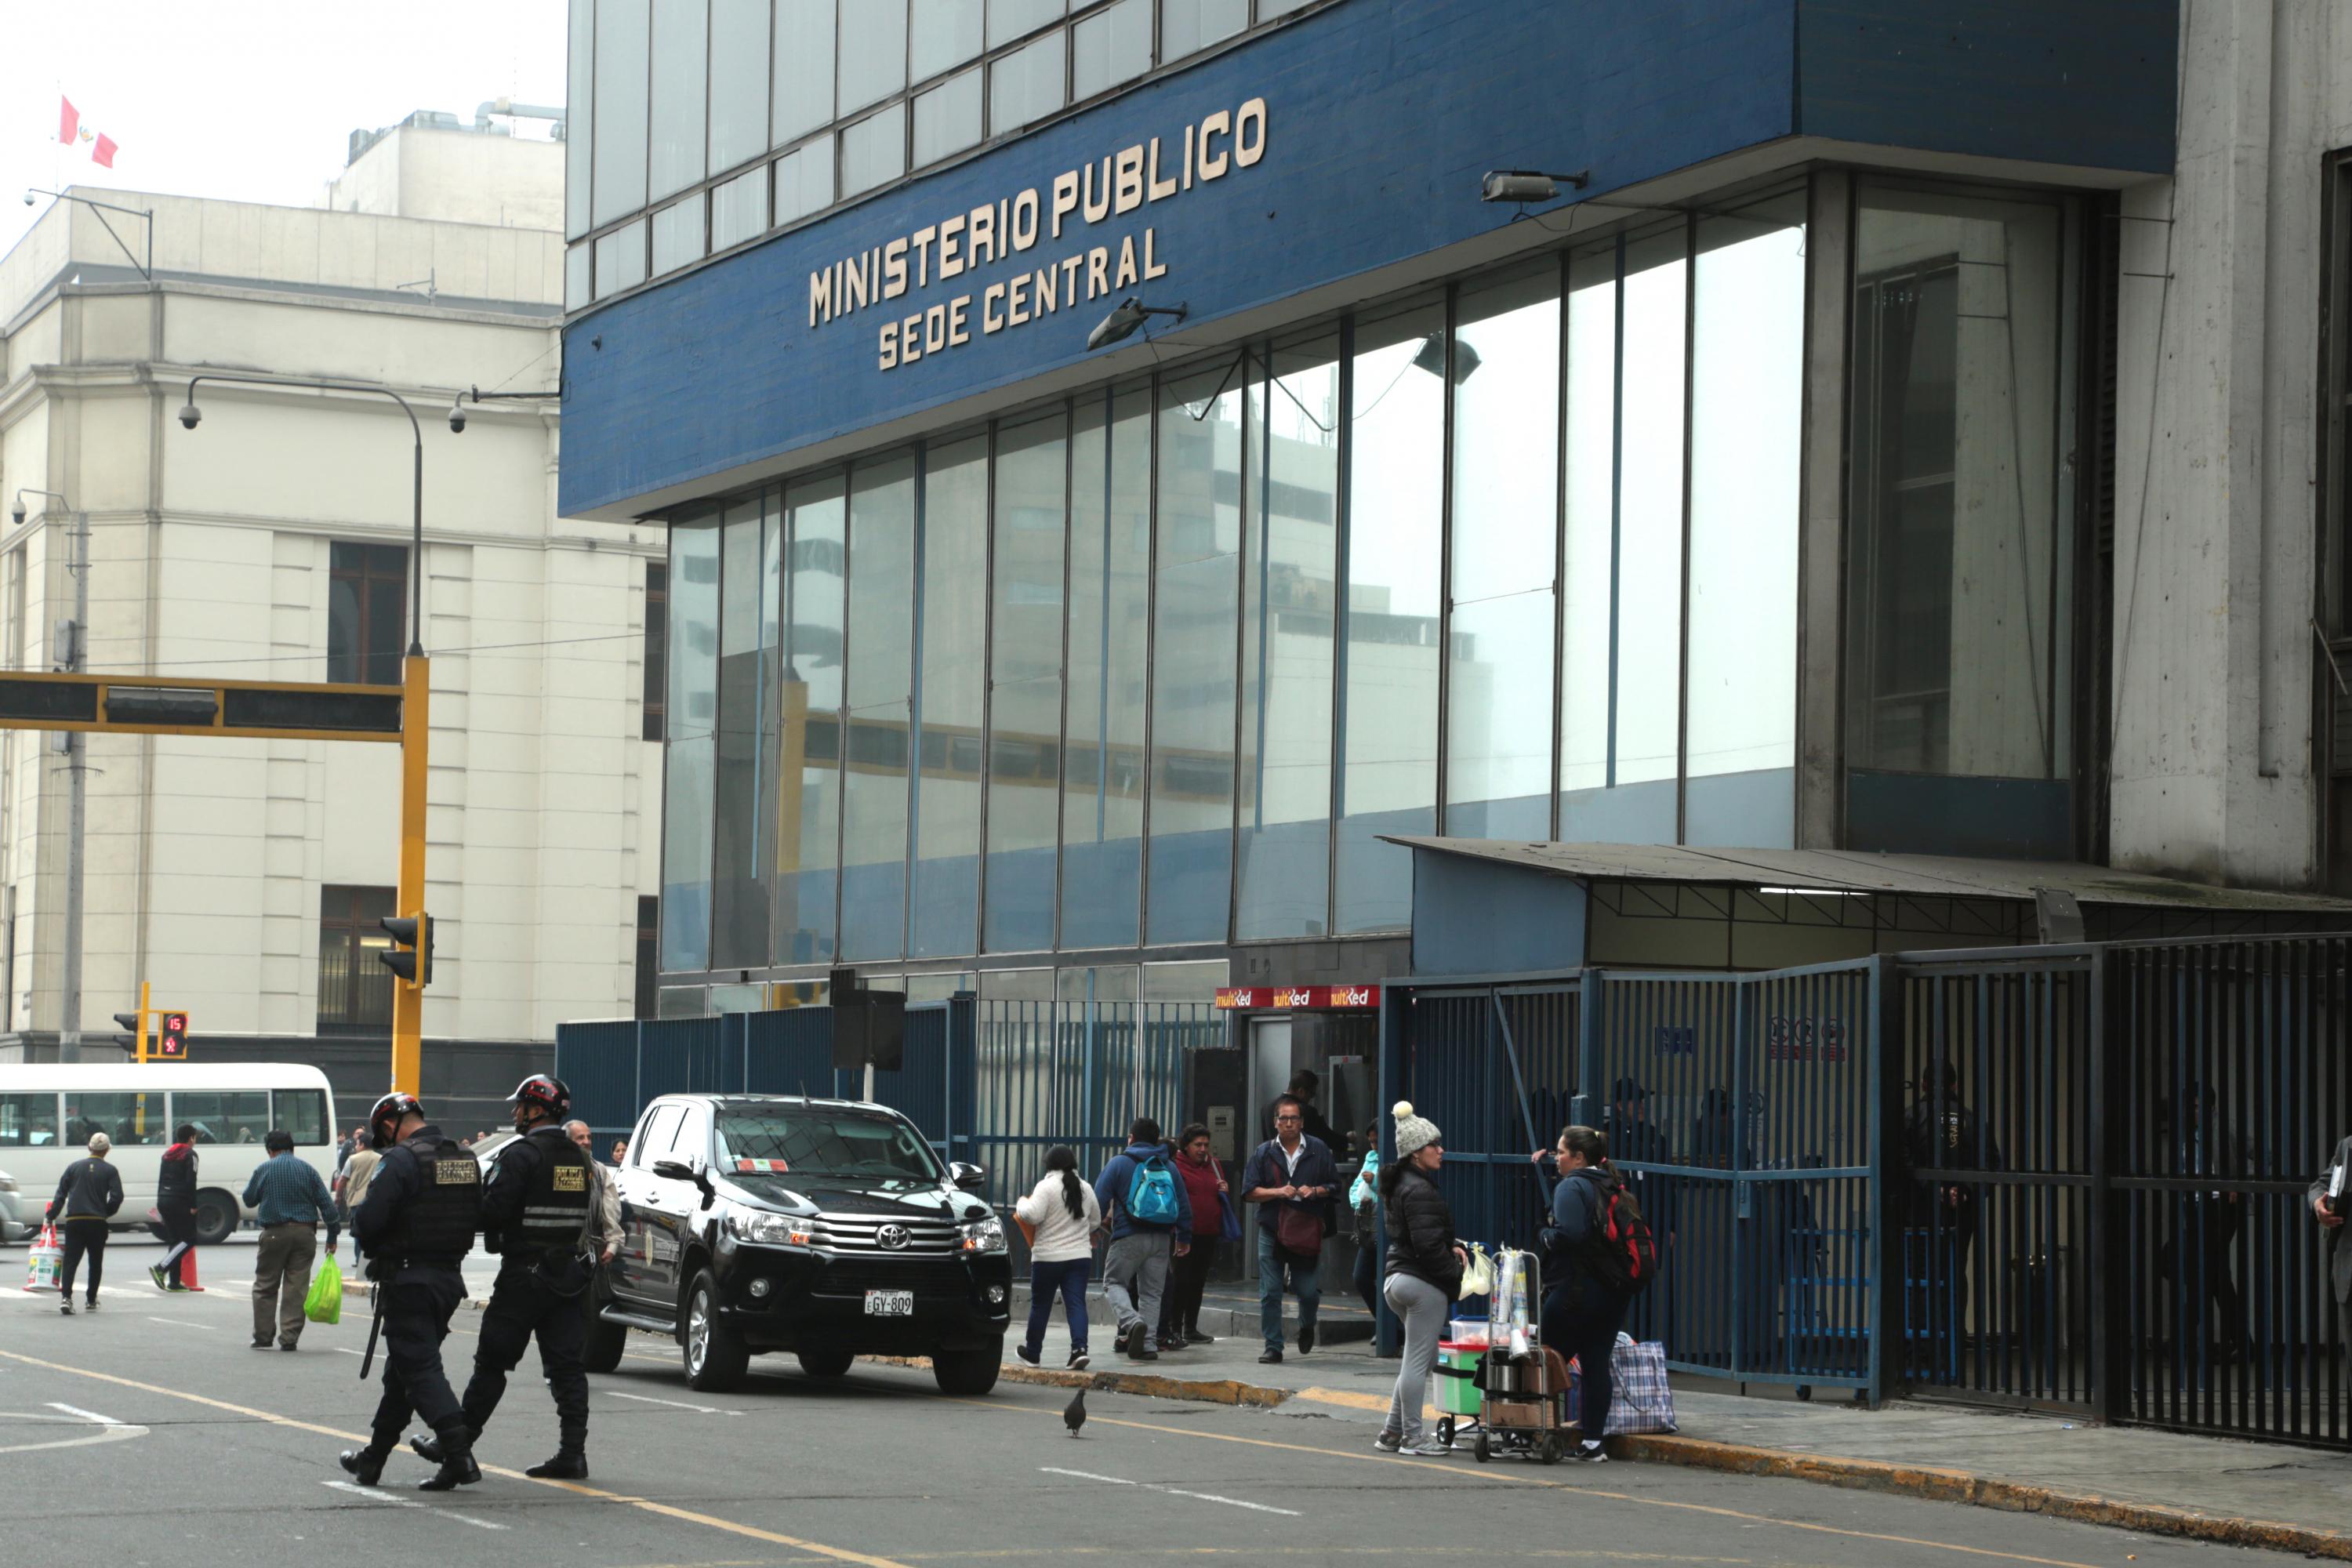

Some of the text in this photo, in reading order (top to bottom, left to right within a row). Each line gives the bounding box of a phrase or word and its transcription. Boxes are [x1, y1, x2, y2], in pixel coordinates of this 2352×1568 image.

[809, 96, 1267, 328] MINISTERIO PUBLICO
[877, 227, 1167, 371] SEDE CENTRAL
[170, 1018, 181, 1030] 15
[436, 1162, 474, 1171] POLICIA
[556, 1169, 584, 1181] POLICIA
